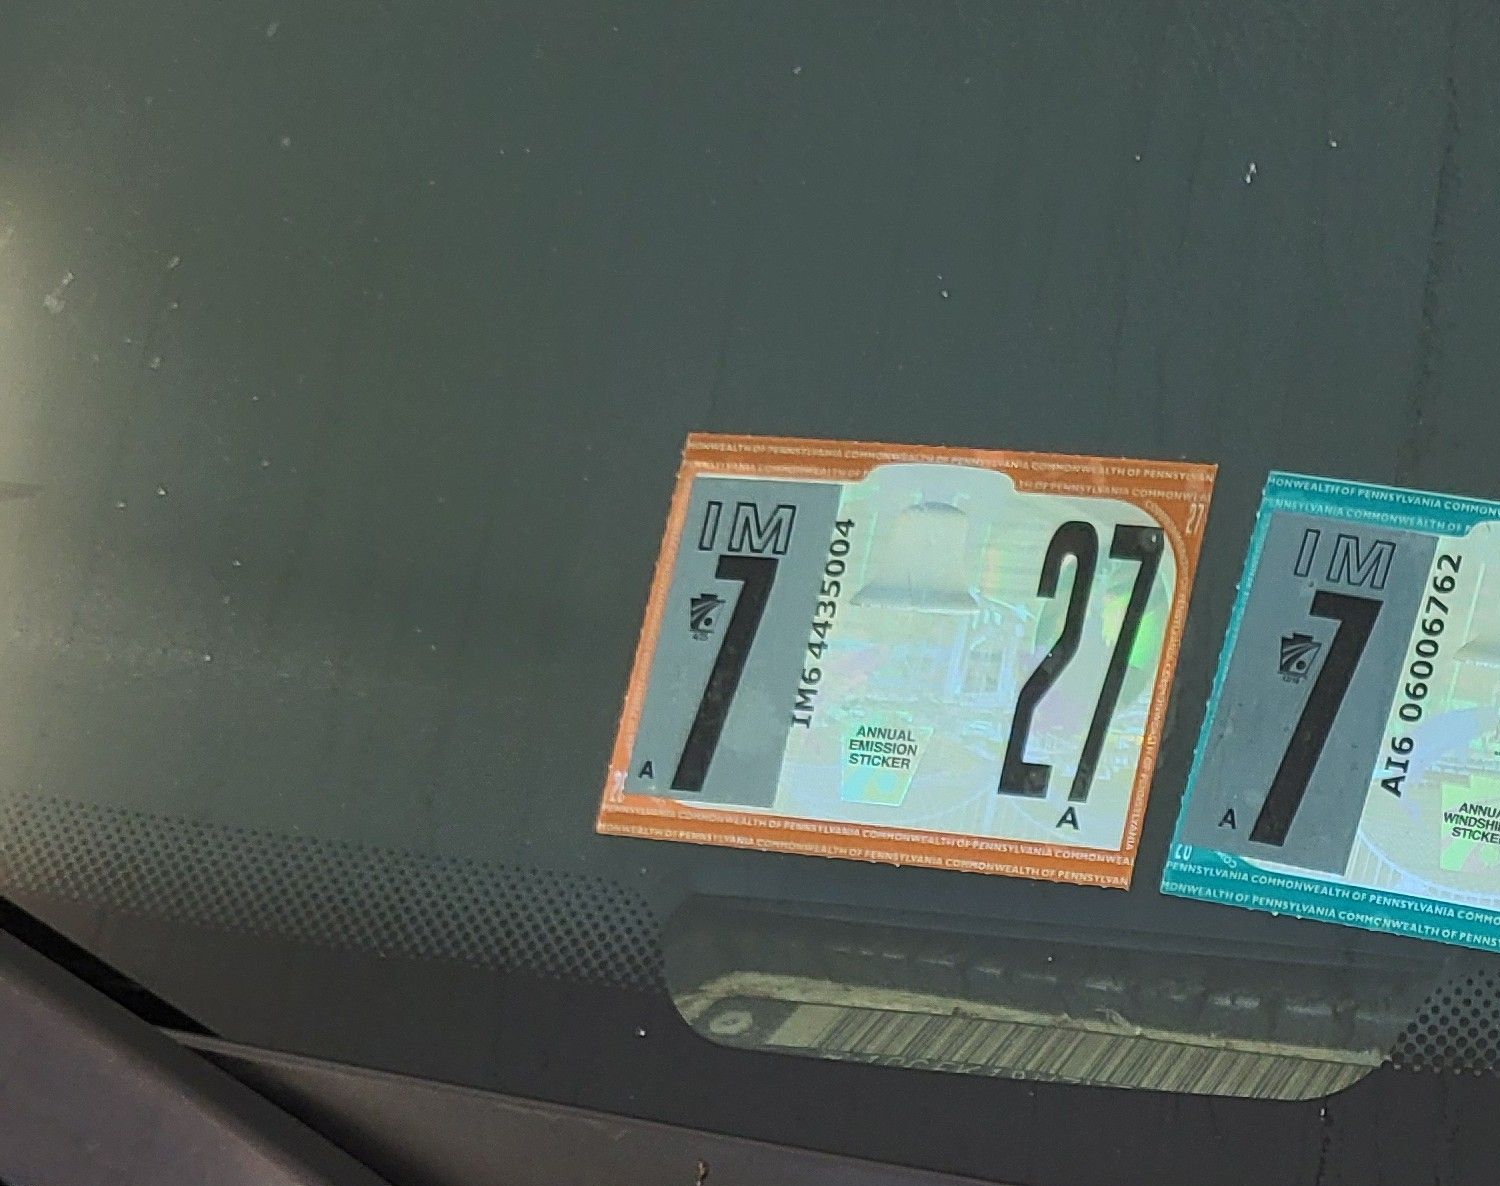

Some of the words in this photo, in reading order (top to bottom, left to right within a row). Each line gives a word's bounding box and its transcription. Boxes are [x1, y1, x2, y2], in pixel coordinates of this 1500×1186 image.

[1357, 488, 1440, 508] PENNSYLVANIA
[698, 501, 796, 555] IM
[1346, 510, 1446, 532] COMMONWEALTH
[1294, 528, 1396, 592] IM
[791, 667, 822, 729] IM6
[807, 518, 855, 660] 4435004
[1398, 553, 1462, 722] 06006762
[671, 554, 779, 792] 7
[998, 520, 1165, 803] 27
[856, 725, 915, 742] ANNUAL
[1248, 590, 1384, 847] 7
[849, 739, 918, 756] EMISSION
[849, 753, 911, 769] STICKER
[638, 760, 655, 779] A
[1055, 806, 1081, 831] A
[1218, 808, 1237, 830] A
[945, 858, 1040, 877] COMMONWEALTH
[1251, 875, 1350, 899] COMMONWEALTH
[1351, 890, 1367, 901] OF
[1369, 894, 1454, 918] PENNSYLVANIA
[1235, 891, 1250, 902] OF
[1252, 895, 1336, 918] PENNSYLVANIA
[1441, 929, 1458, 940] OF
